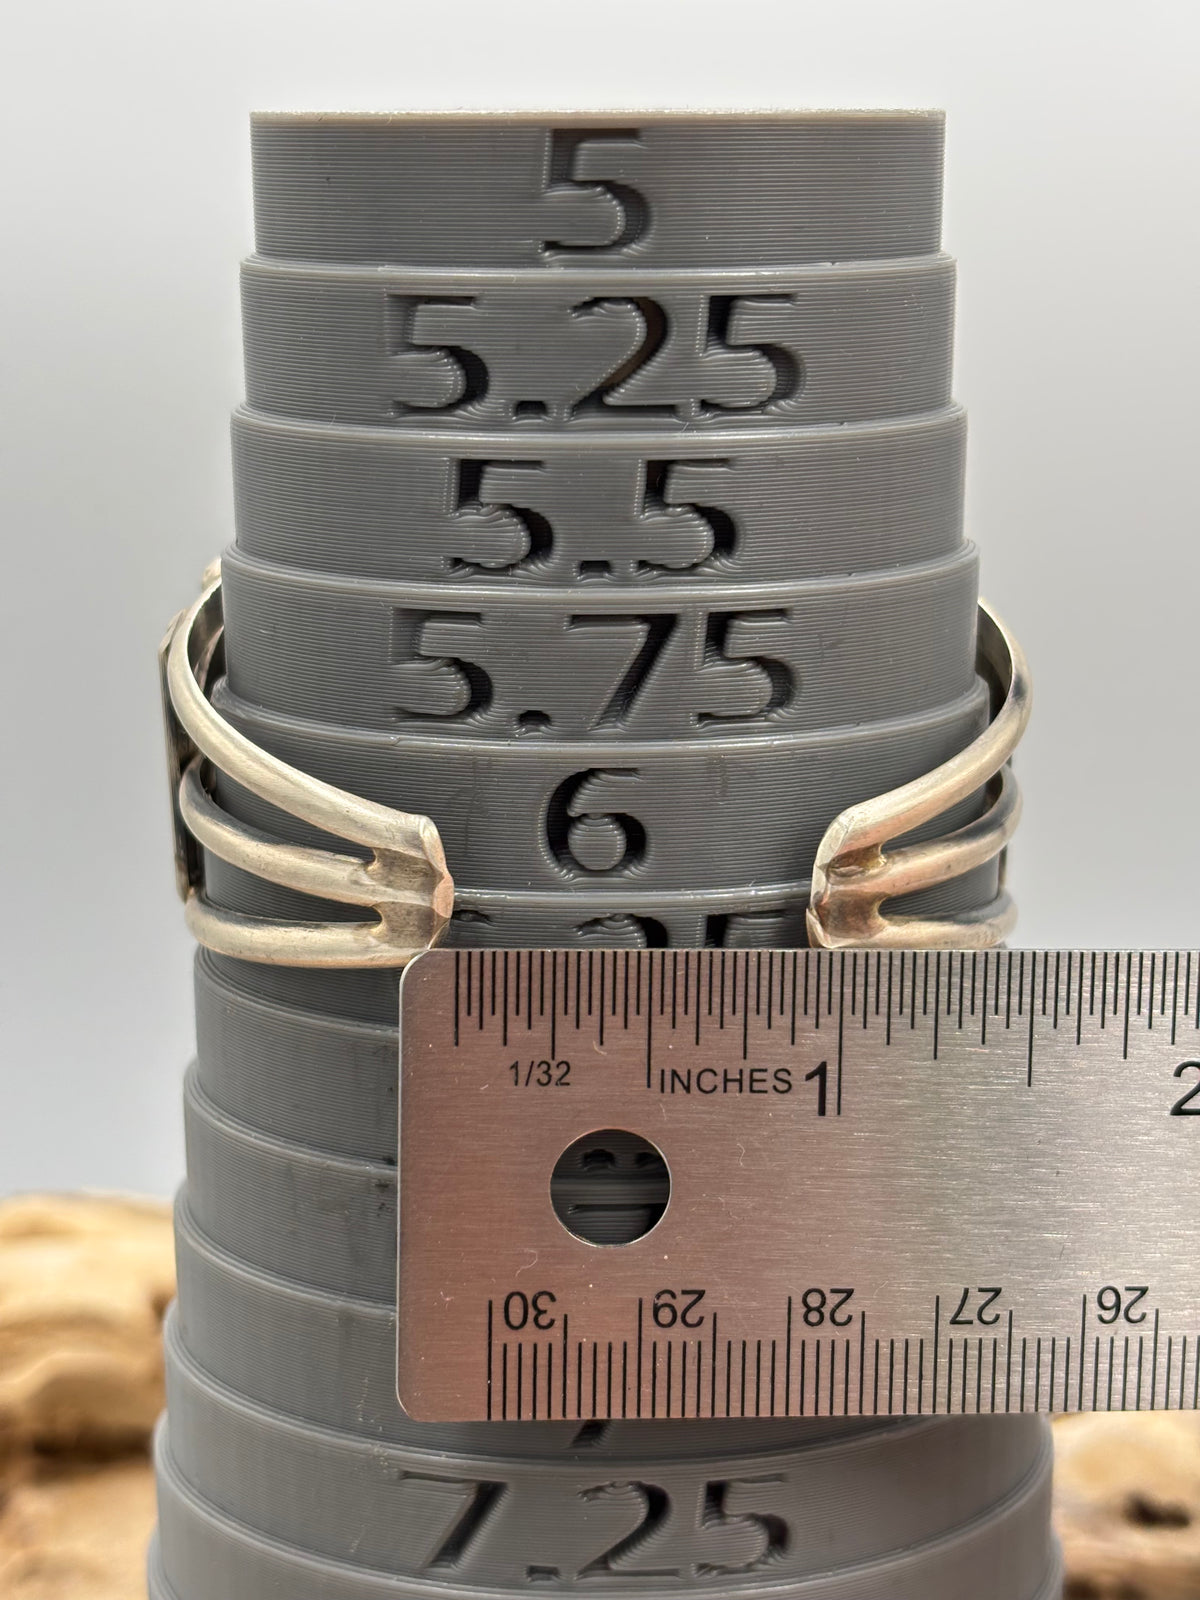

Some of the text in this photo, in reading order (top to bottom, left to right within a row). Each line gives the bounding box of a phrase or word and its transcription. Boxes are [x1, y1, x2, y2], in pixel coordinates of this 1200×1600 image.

[538, 127, 651, 263] 5
[384, 292, 806, 420] 5.25
[441, 458, 744, 576] 5.5
[387, 609, 798, 732] 5.75
[538, 767, 649, 882] 6
[509, 1060, 571, 1087] 1/32
[659, 1068, 793, 1095] INCHES
[805, 1060, 828, 1117] 1
[1169, 1060, 1200, 1116] 2
[503, 1291, 557, 1331] 30
[652, 1289, 707, 1328] 29
[801, 1288, 856, 1327] 28
[948, 1287, 1001, 1326] 27
[1096, 1285, 1150, 1324] 26
[400, 1472, 792, 1582] 7.25
